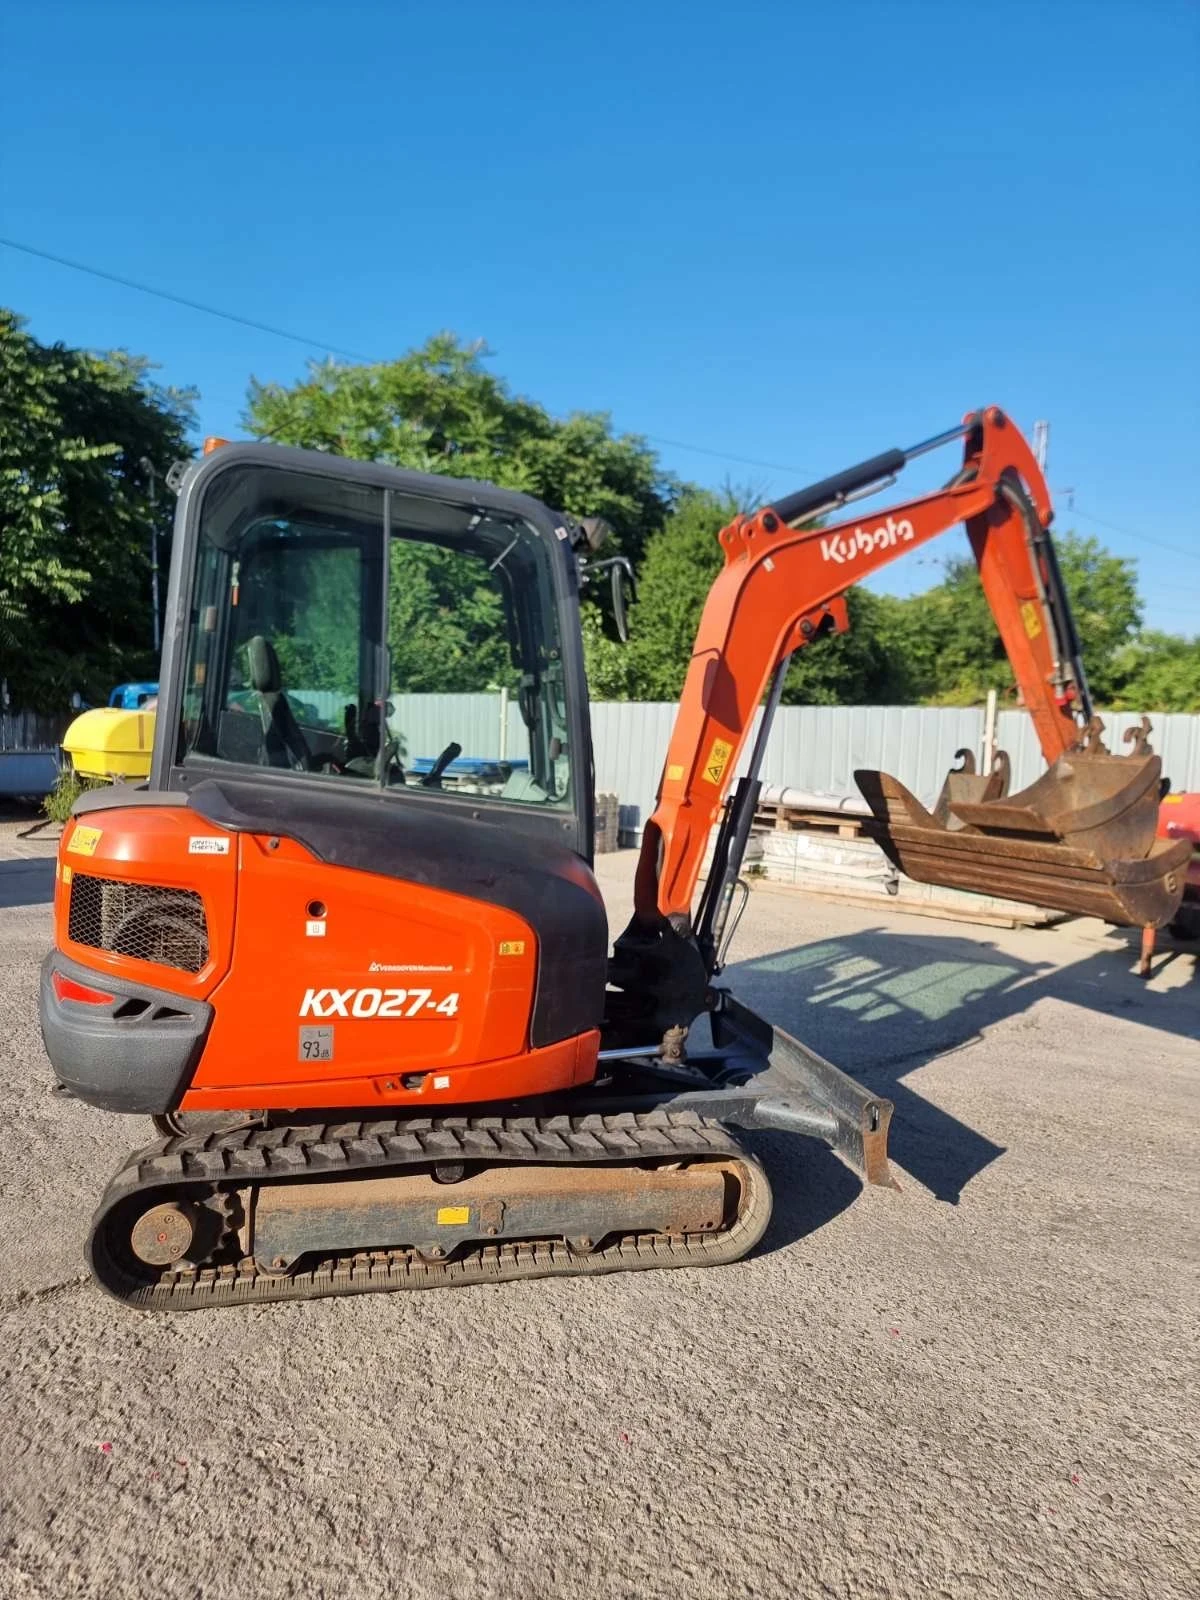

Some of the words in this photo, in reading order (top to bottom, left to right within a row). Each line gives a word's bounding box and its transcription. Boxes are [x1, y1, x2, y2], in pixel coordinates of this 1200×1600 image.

[820, 516, 915, 564] Kubota
[298, 987, 460, 1018] KX027-4
[302, 1040, 320, 1059] 93
